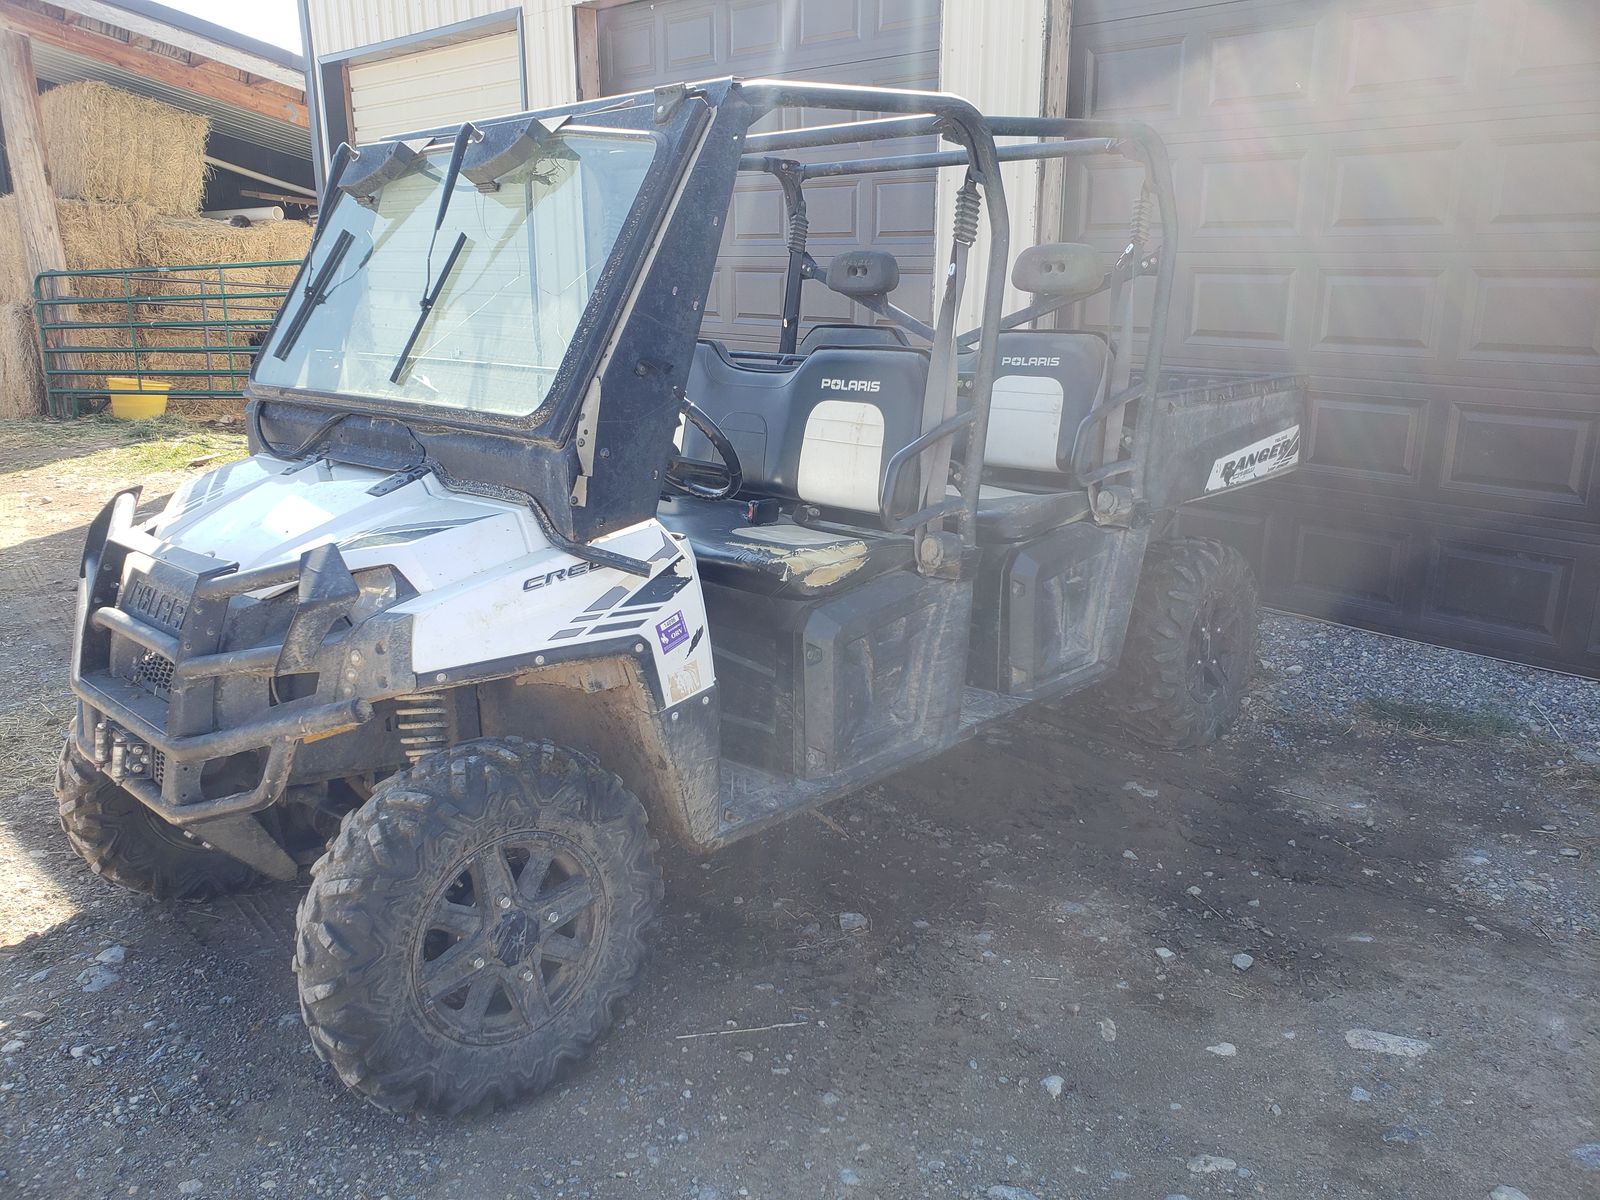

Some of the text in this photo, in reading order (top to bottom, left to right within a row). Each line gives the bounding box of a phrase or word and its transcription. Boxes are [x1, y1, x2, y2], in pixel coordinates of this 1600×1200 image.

[1001, 356, 1061, 367] POLARIS
[820, 378, 881, 393] POLARIS
[1220, 438, 1291, 479] RANGER
